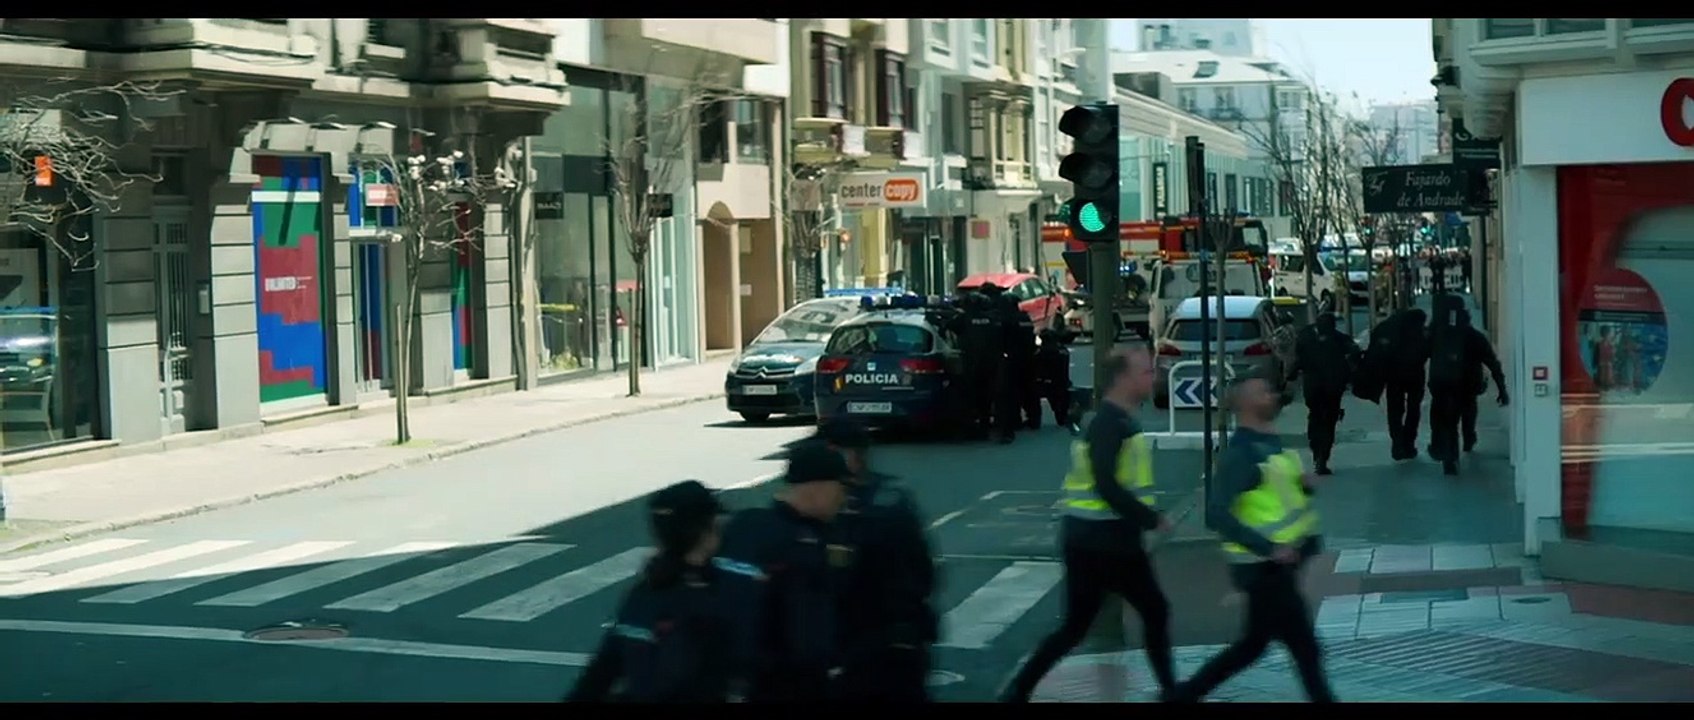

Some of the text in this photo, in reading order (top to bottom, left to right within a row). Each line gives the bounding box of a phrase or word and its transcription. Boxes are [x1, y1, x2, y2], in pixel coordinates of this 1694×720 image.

[1405, 170, 1451, 188] Fajardo
[840, 182, 917, 201] center copy
[1396, 191, 1466, 208] de Andrade
[844, 372, 899, 385] POLICIA
